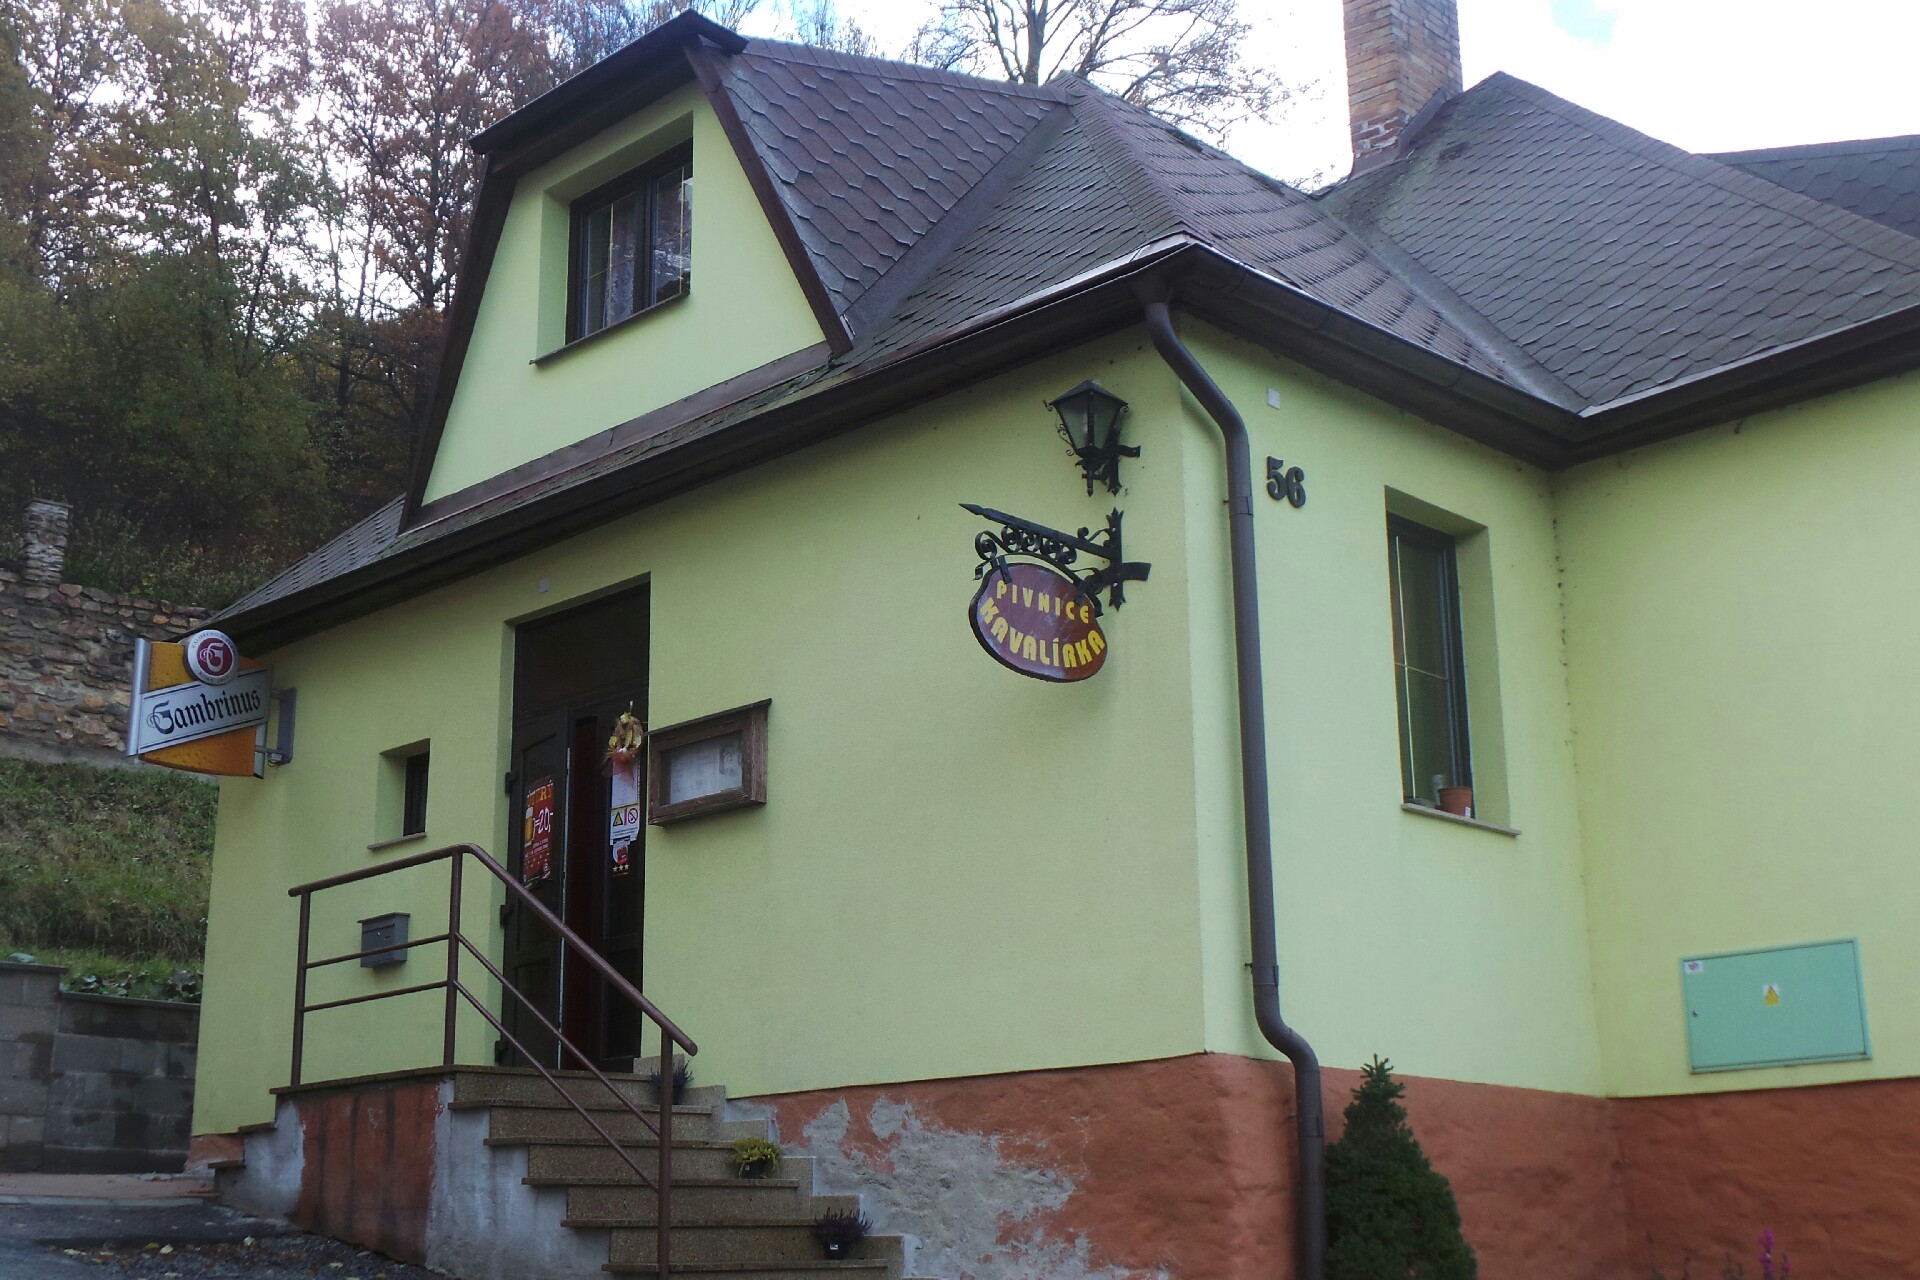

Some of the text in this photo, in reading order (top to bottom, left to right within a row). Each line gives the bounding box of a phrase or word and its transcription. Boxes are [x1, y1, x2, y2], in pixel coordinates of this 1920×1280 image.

[1266, 455, 1306, 509] 56
[996, 580, 1089, 624] PIVNICE
[980, 597, 1105, 668] KAVALÍRKA
[146, 690, 261, 734] Gambrinus
